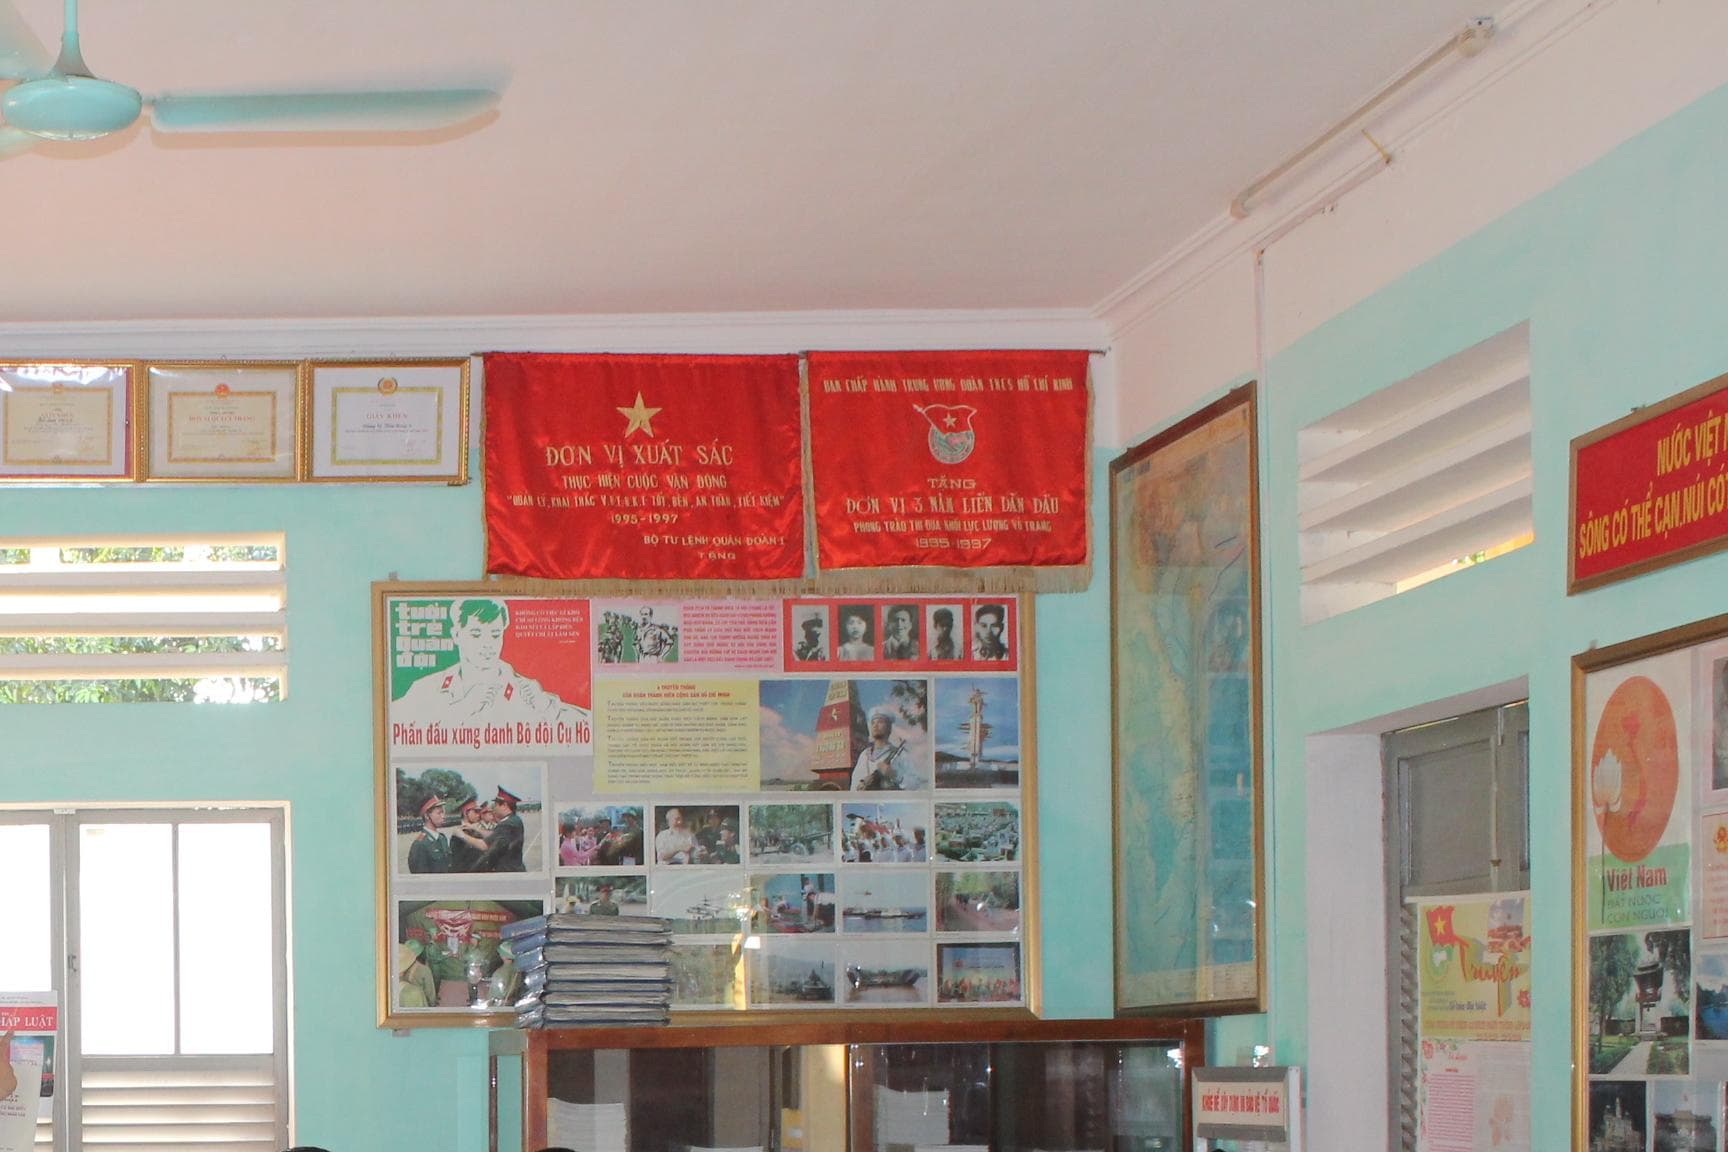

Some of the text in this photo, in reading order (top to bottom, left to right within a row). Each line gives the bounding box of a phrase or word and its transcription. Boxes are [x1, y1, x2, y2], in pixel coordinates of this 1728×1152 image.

[545, 438, 733, 468] ĐƠN VỊ XUẤT SẮC
[1657, 410, 1722, 476] NƯỚC VIỆT
[562, 474, 591, 490] THỰC
[598, 474, 621, 489] HIỆN
[627, 475, 658, 490] CUỘC
[666, 475, 689, 489] VẬN
[847, 495, 880, 514] ĐƠN
[890, 498, 905, 515] VỊ
[914, 498, 923, 513] 3
[1579, 510, 1610, 559] SÔNG
[1611, 498, 1629, 548] CÓ
[1631, 481, 1654, 541] THỂ
[1707, 463, 1726, 516] CÓ
[611, 513, 679, 524] 1995-1997
[643, 534, 777, 547] BỘ TƯ LỆNH QUÂN ĐOÀN
[392, 718, 591, 750] Phấn đấu xứng danh Bộ đội Cụ Hồ
[1636, 864, 1667, 888] Nam
[24, 1013, 54, 1028] LUẬT
